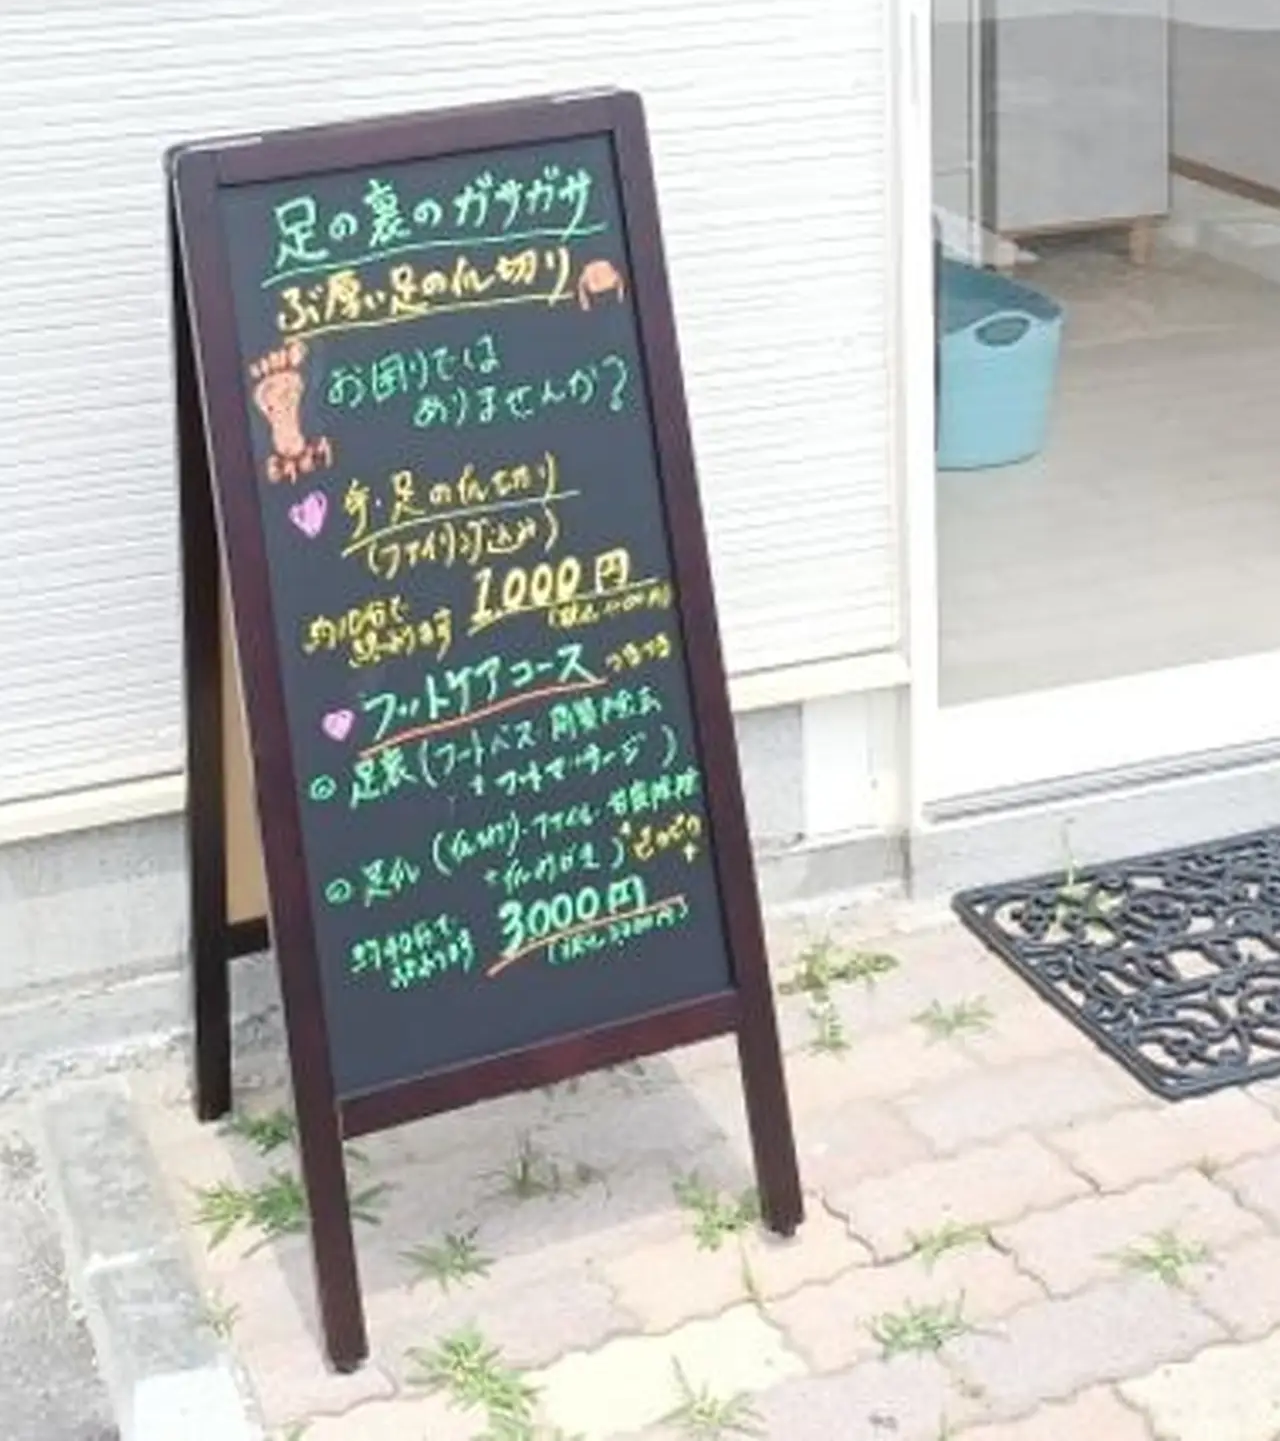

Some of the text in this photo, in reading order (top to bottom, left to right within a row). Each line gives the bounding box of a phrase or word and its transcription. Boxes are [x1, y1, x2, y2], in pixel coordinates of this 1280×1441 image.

[274, 164, 593, 266] 足の裏のガサガサ
[327, 335, 501, 408] お困りでは
[362, 642, 598, 741] フットケアコース
